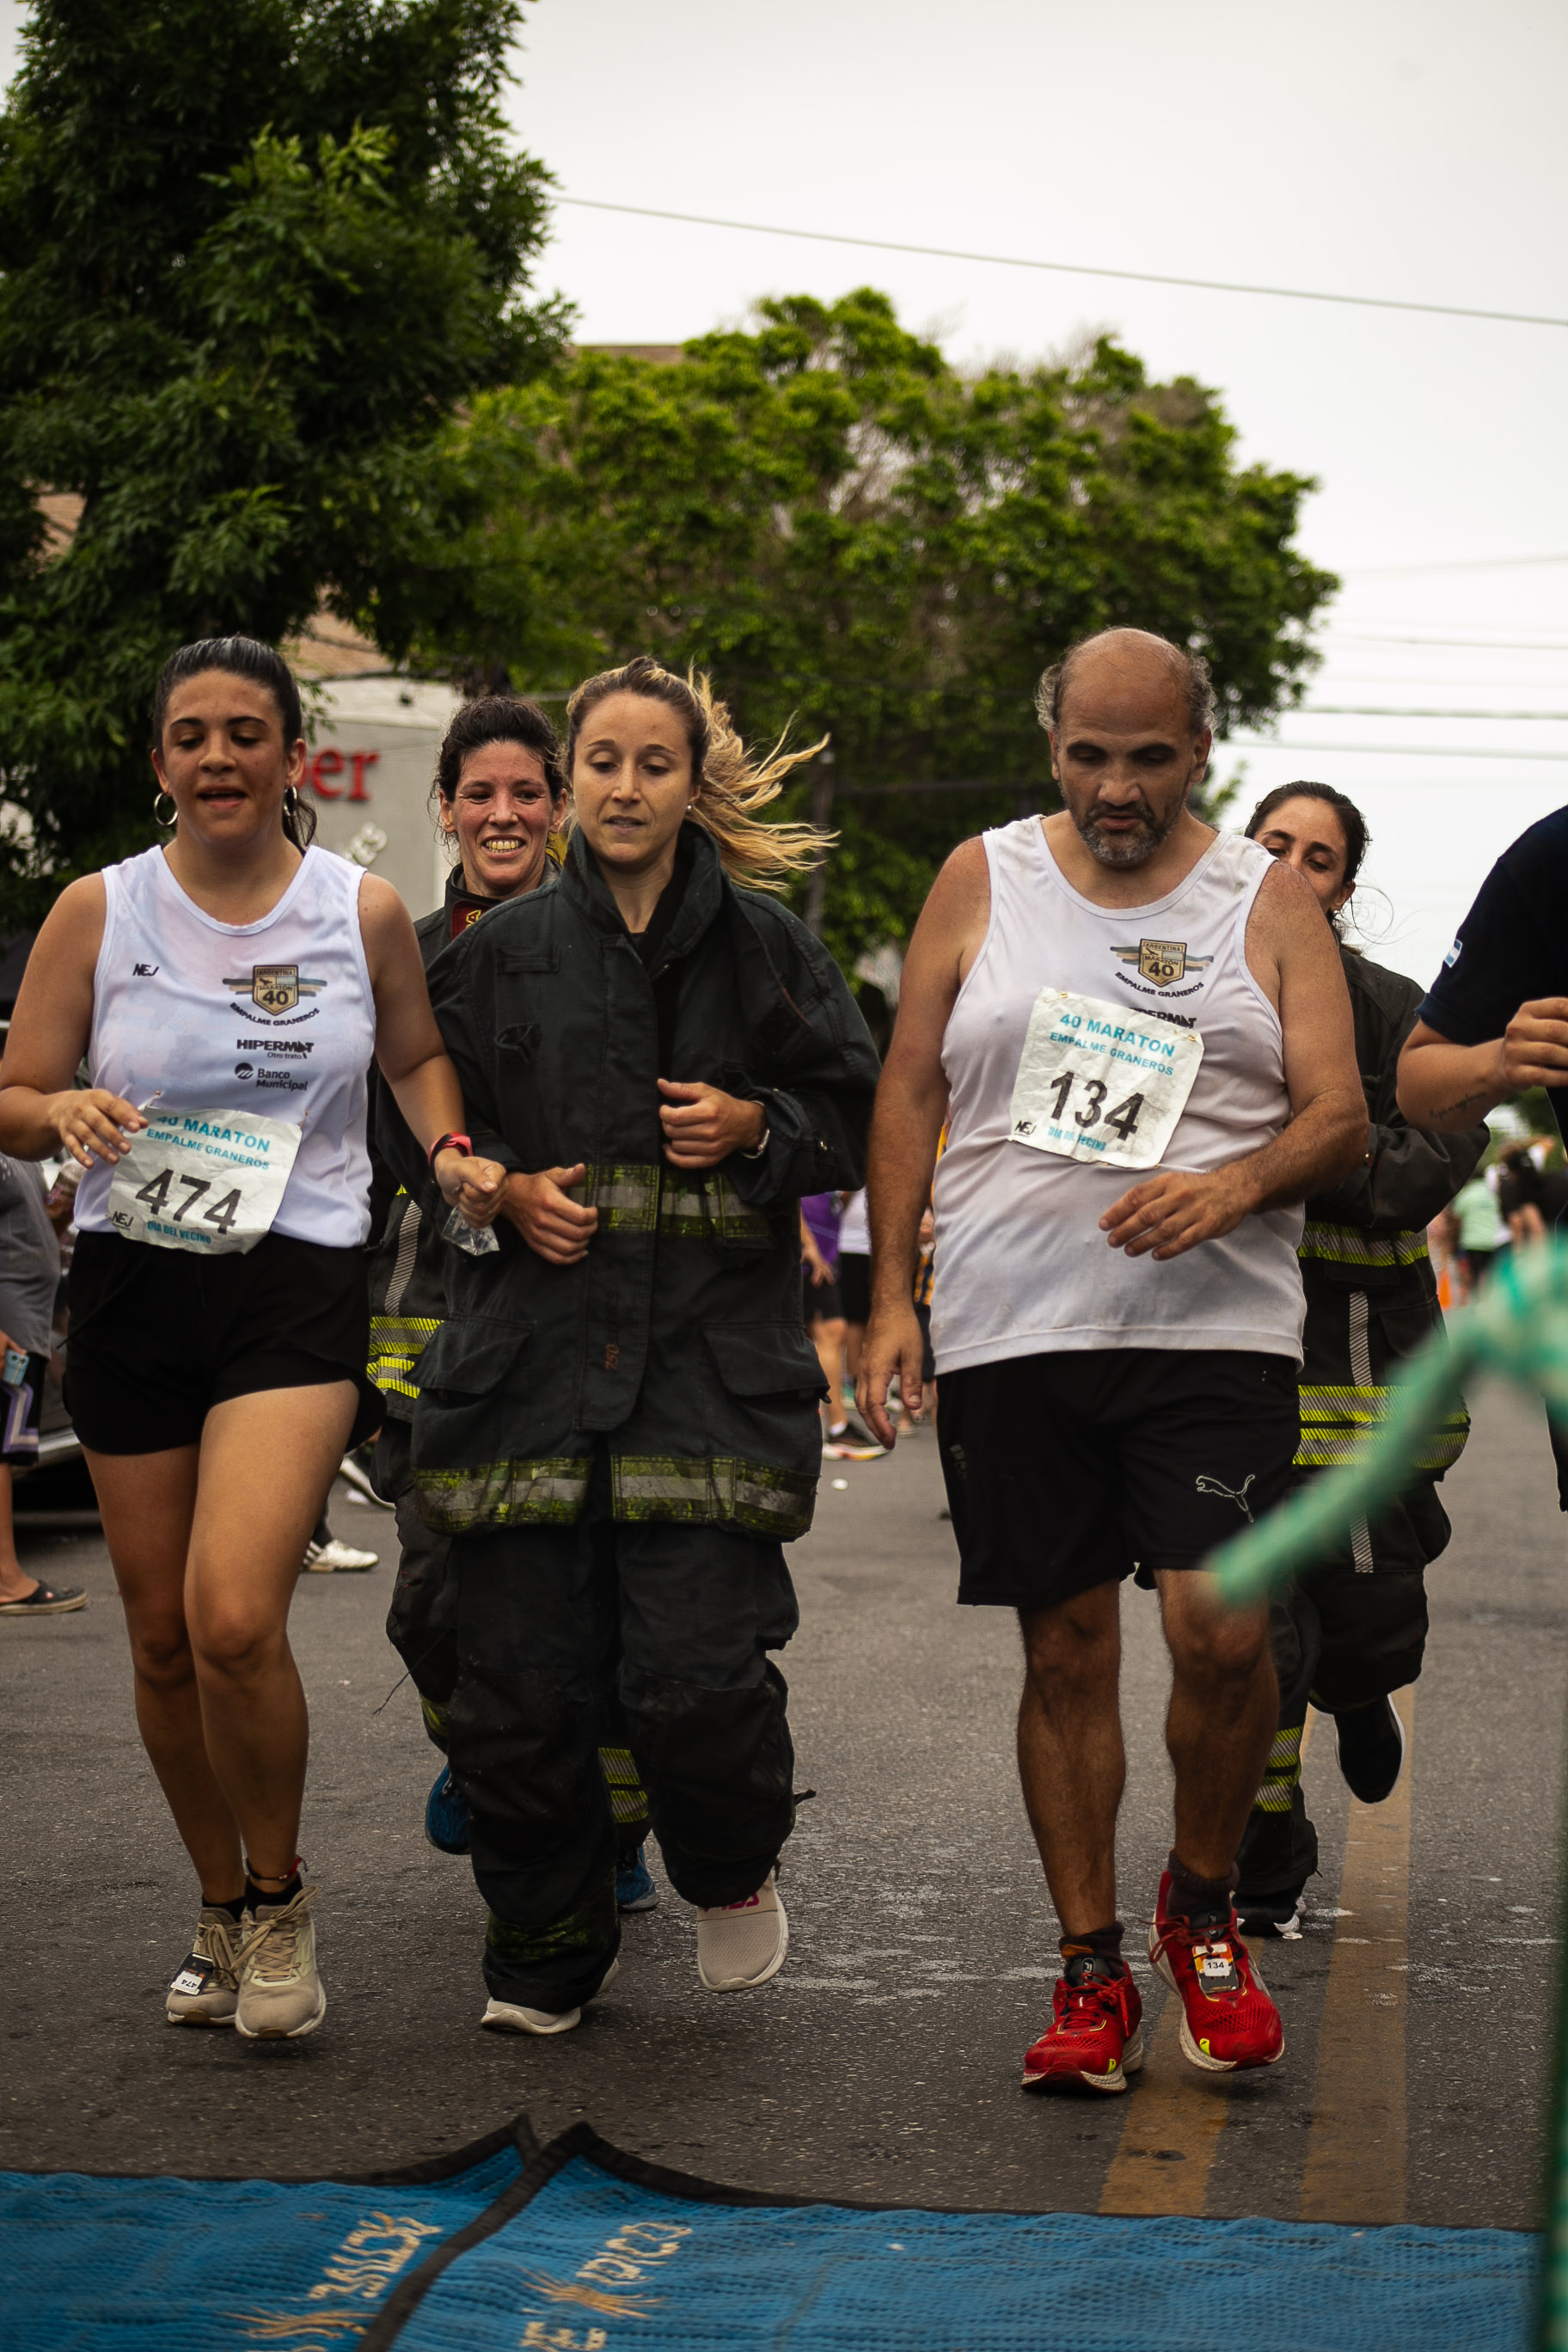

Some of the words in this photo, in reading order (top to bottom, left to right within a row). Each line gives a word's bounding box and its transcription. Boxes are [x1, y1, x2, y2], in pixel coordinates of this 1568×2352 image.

[299, 746, 379, 801] er
[1146, 943, 1180, 952] ARGENTINA
[1148, 962, 1174, 977] 40
[1115, 971, 1155, 995] EMPALME
[1158, 982, 1204, 997] GRANEROS
[262, 991, 289, 1006] 40
[230, 1002, 271, 1026] EMPALME
[273, 1008, 320, 1026] GRANEROS
[1060, 1014, 1081, 1028] 40
[1087, 1019, 1175, 1057] MARATON
[1050, 1032, 1107, 1053] EMPALME
[1110, 1048, 1173, 1076] GRANEROS
[256, 1080, 309, 1092] Municipal
[258, 1069, 291, 1080] Banco
[1050, 1070, 1144, 1142] 134
[157, 1116, 179, 1126] 40
[183, 1118, 271, 1152] MARATON
[146, 1128, 204, 1151] EMPALME
[205, 1145, 270, 1170] GRANEROS
[135, 1167, 242, 1234] 474
[147, 1221, 162, 1233] DIA
[162, 1224, 178, 1237] DEL
[179, 1229, 211, 1244] VECINO
[181, 1979, 197, 1988] 474
